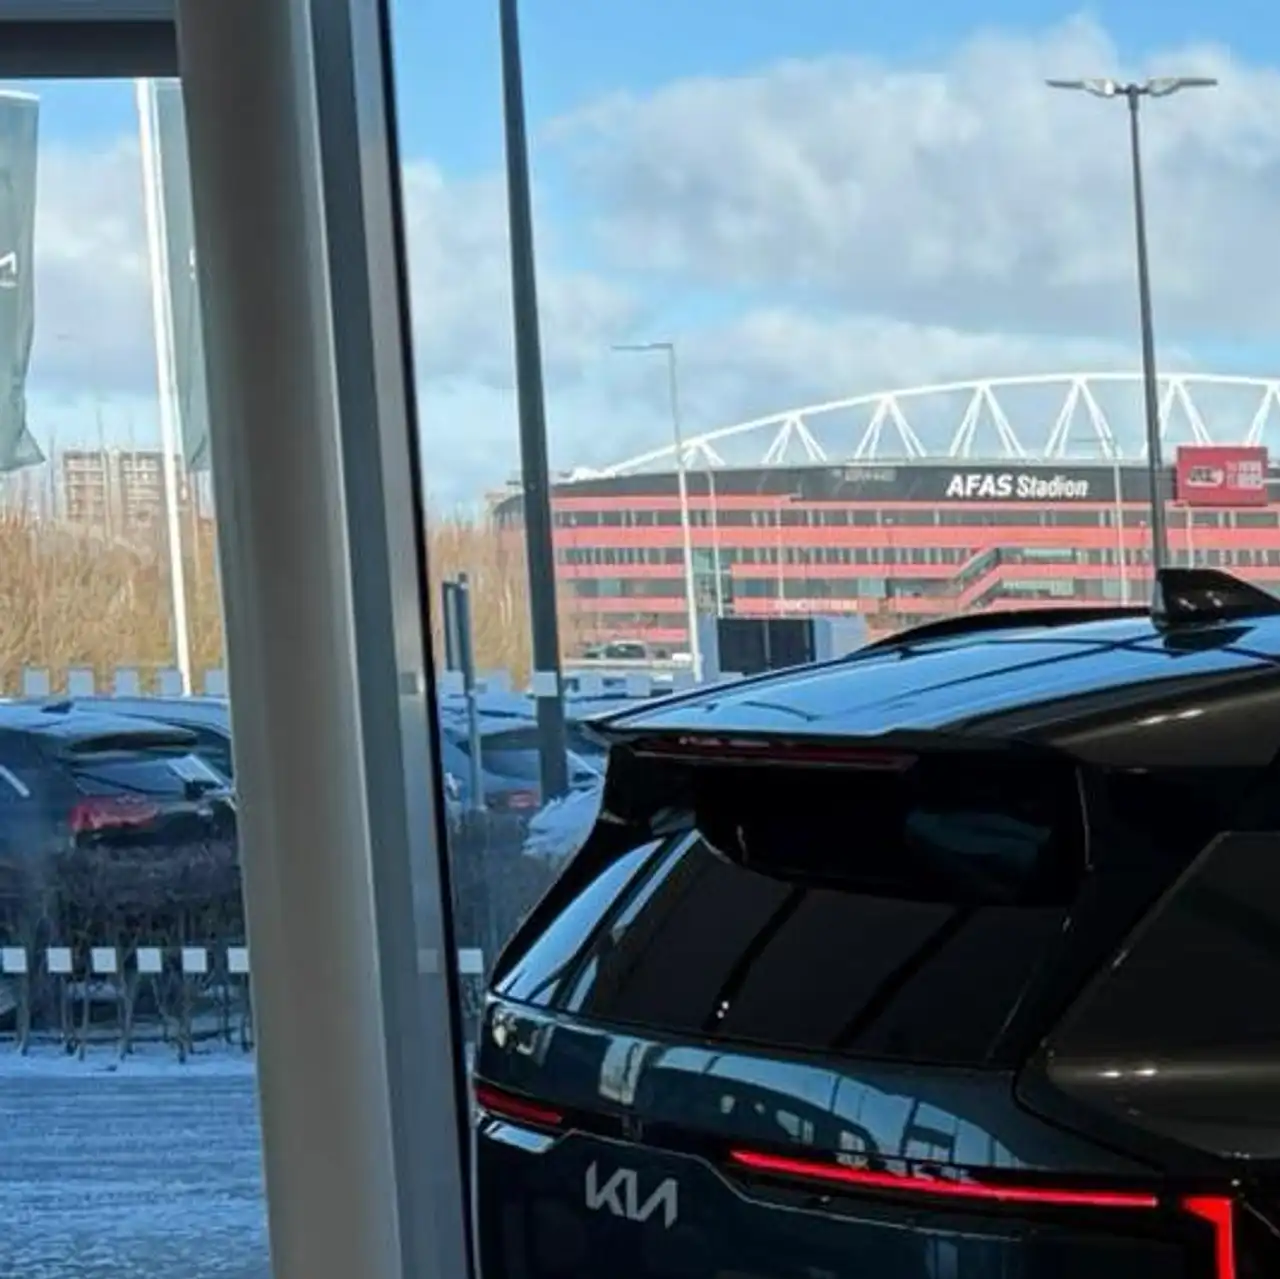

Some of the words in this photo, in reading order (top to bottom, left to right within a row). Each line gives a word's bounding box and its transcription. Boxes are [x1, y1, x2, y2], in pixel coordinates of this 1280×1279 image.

[945, 473, 1013, 497] AFAS
[1015, 474, 1090, 498] Stadion
[585, 1159, 679, 1230] KIA
